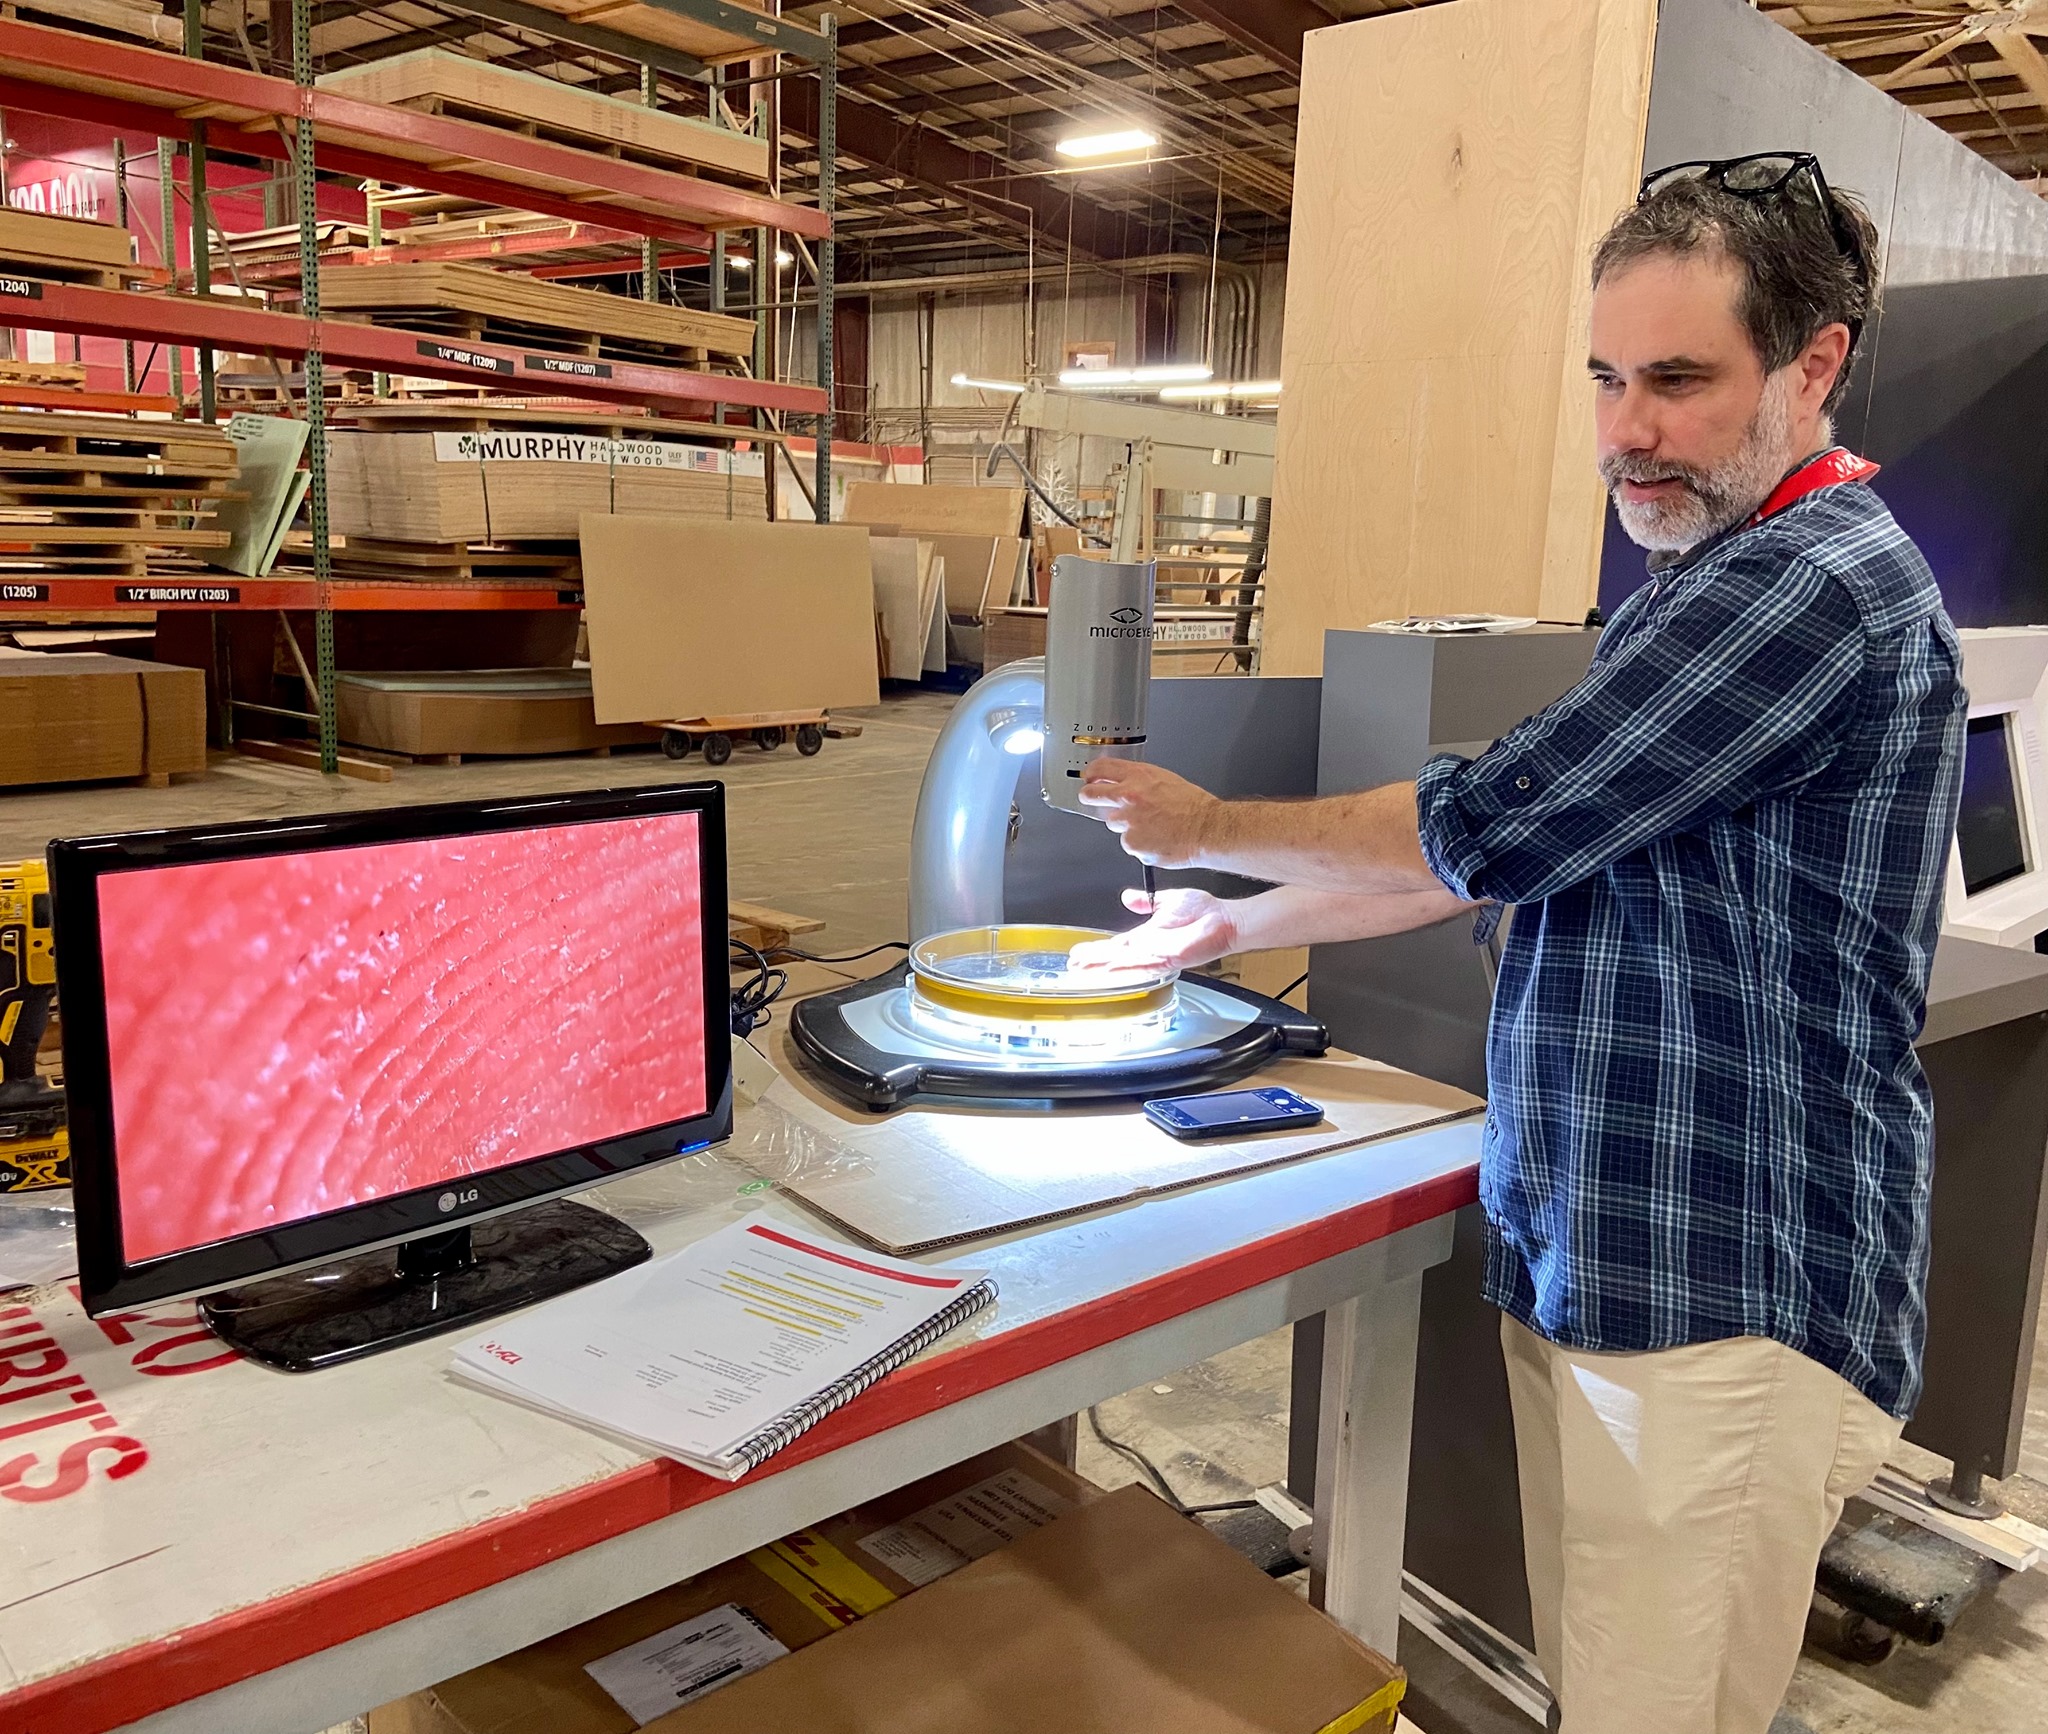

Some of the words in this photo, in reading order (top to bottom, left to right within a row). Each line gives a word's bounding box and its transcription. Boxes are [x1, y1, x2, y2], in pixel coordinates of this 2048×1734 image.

[454, 350, 472, 364] MDF
[472, 353, 498, 371] (1209)
[559, 361, 574, 373] MDF
[574, 362, 597, 376] (1207)
[481, 437, 586, 460] MURPHY
[2, 586, 37, 600] (1205)
[128, 588, 149, 600] 1/2"
[149, 588, 179, 600] BIRCH
[179, 588, 198, 600] PLY
[199, 588, 230, 602] (1203)
[15, 1149, 59, 1164] DEWALT
[460, 1188, 479, 1205] LG
